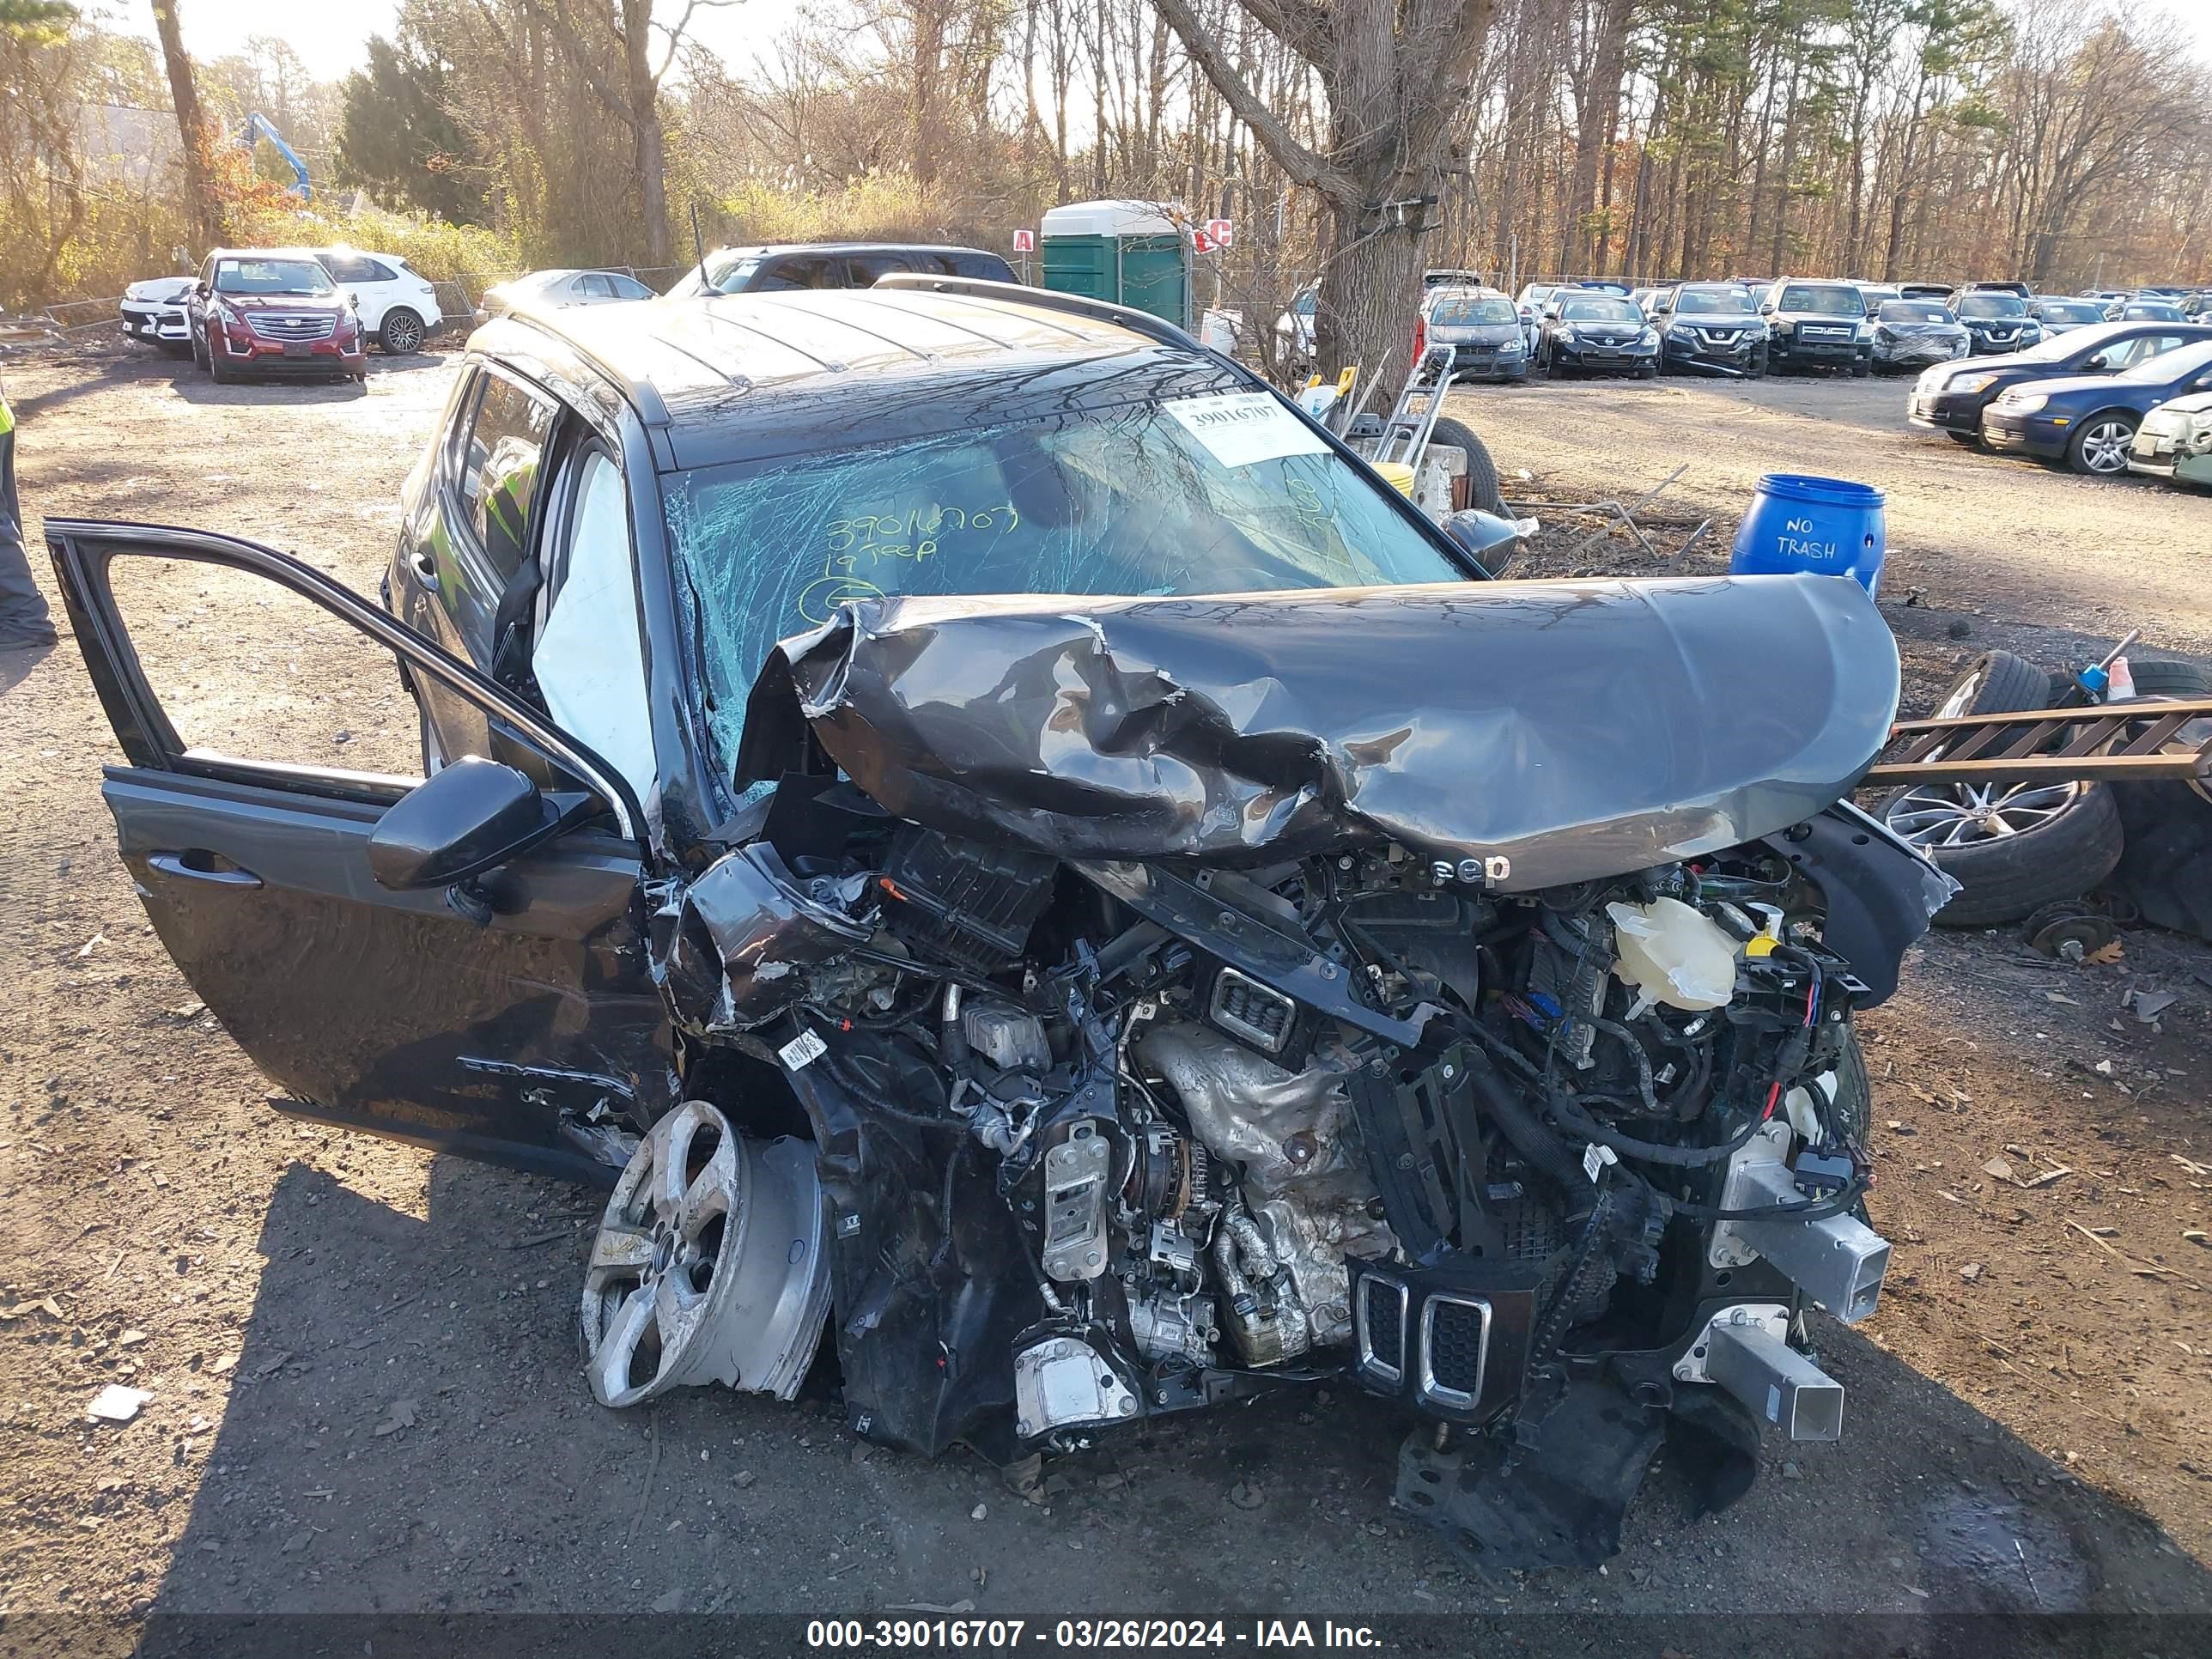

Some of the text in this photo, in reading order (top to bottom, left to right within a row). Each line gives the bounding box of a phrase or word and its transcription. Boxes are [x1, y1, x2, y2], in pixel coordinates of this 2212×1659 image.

[1016, 232, 1031, 249] A
[1211, 221, 1231, 245] C
[1189, 405, 1279, 427] 39016707
[827, 507, 1018, 550] 39016707
[1786, 517, 1813, 532] NO
[1778, 536, 1835, 559] TRASH
[825, 554, 857, 577] 19
